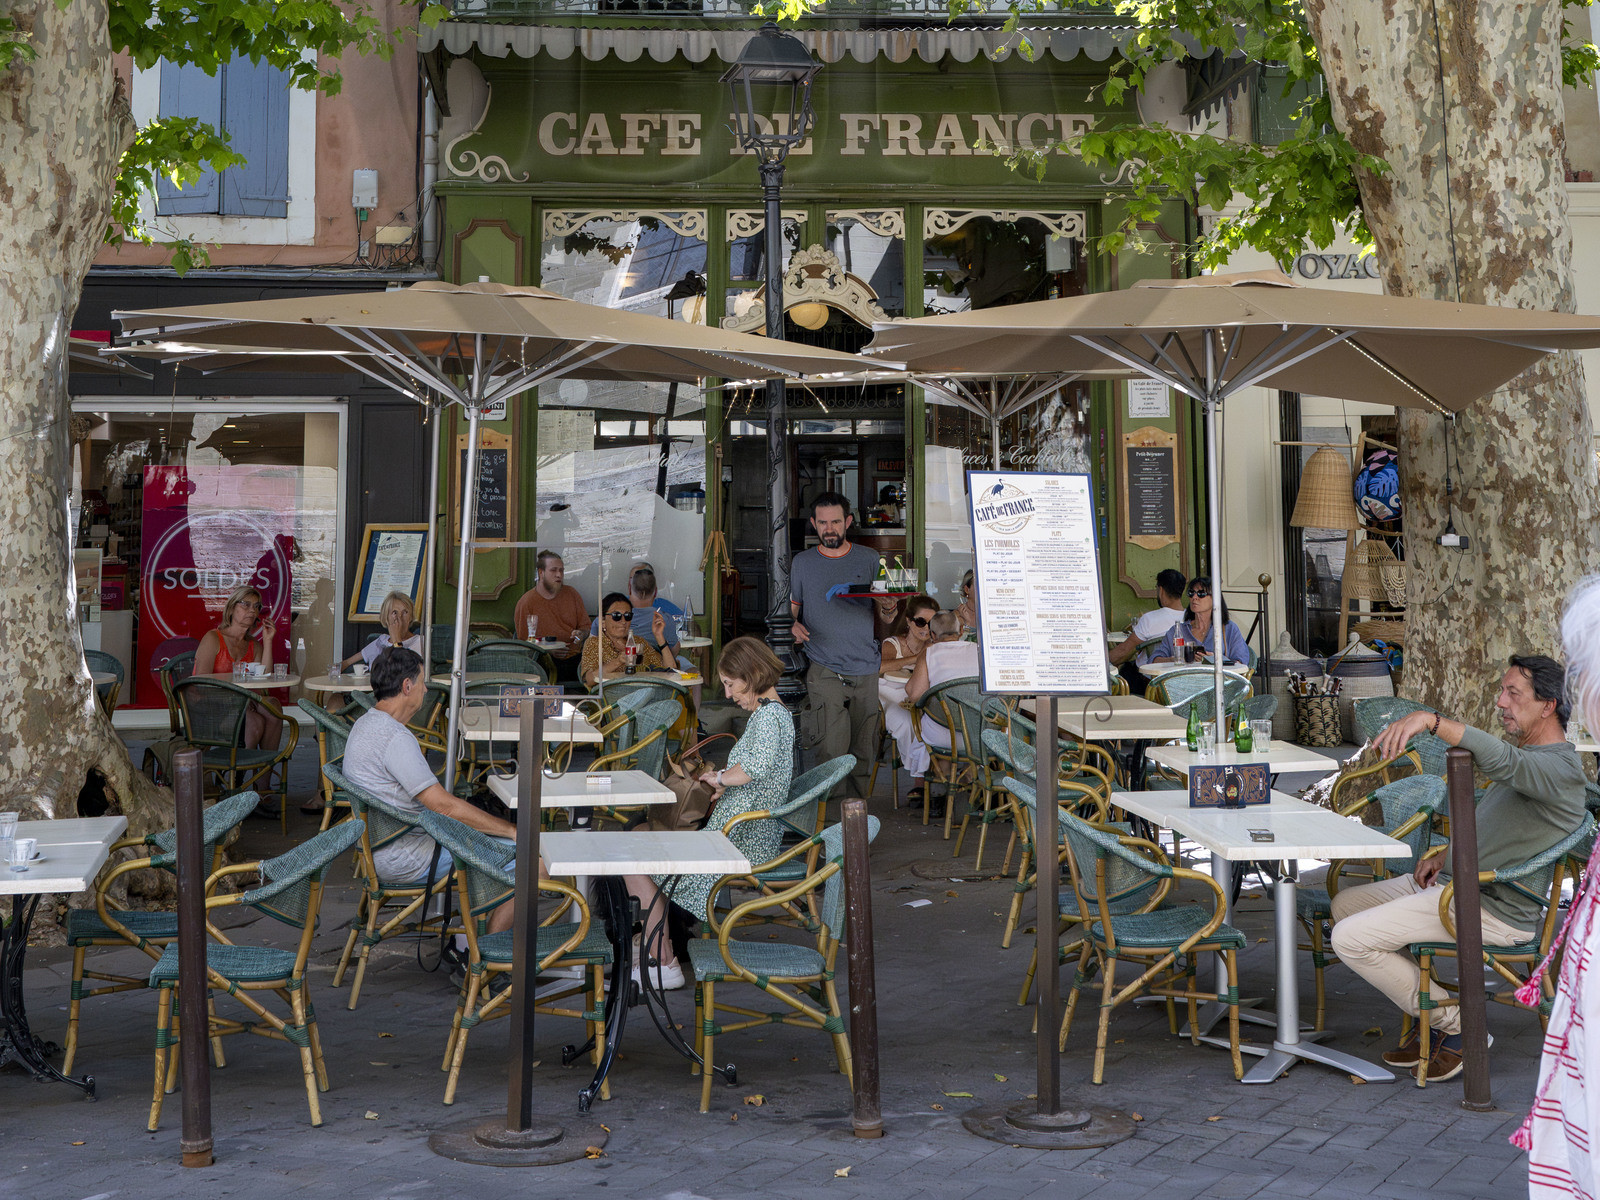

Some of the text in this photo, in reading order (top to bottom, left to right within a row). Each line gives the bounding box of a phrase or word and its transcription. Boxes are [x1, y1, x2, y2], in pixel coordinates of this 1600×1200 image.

[538, 111, 1096, 155] CAFE DE FRANCE
[955, 445, 989, 465] laces
[975, 502, 998, 522] CAFÉ
[1003, 497, 1036, 517] FRANCE
[163, 567, 270, 590] SOLDES
